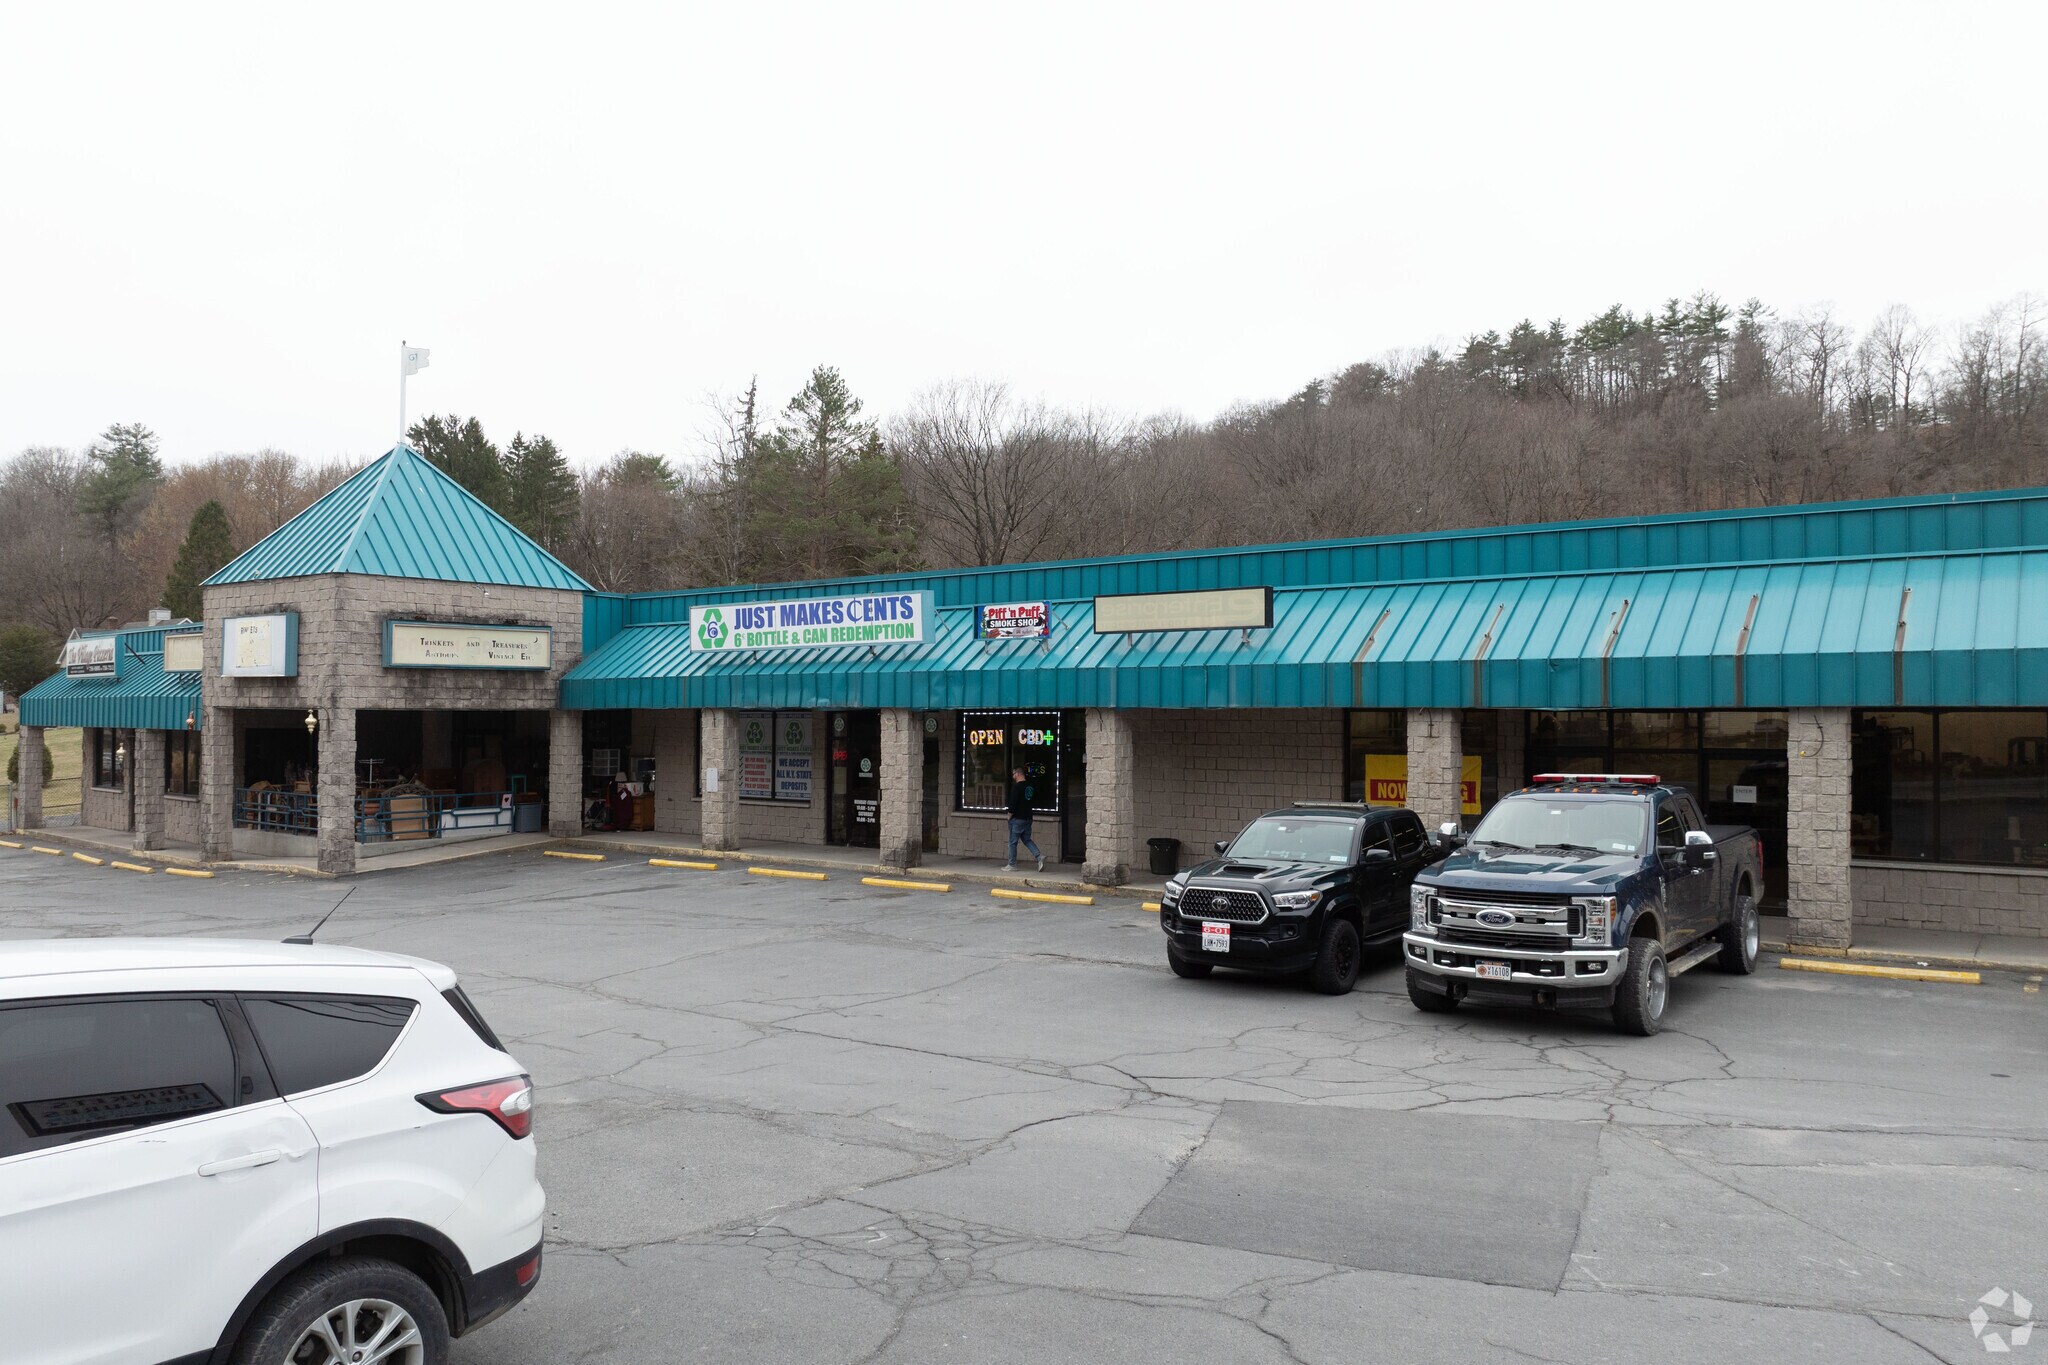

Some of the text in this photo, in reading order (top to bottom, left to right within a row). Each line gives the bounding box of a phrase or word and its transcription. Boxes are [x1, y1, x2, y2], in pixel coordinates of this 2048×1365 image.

[734, 605, 776, 630] JUST
[780, 601, 844, 627] MAKES
[988, 607, 1007, 620] Piff
[1018, 605, 1041, 620] Puff
[990, 618, 1039, 628] SMOKE SHOP
[747, 630, 788, 647] BOTTLE
[792, 631, 800, 644] &
[803, 628, 827, 644] CAN
[831, 623, 914, 643] REDEMPTION
[420, 638, 454, 647] TRINKETS
[492, 640, 528, 649] TREASURES
[969, 729, 1004, 745] OPEN
[779, 759, 809, 768] WE ACCEPT
[776, 770, 785, 778] ALL
[796, 771, 812, 780] STATE
[780, 781, 807, 791] DEPOSITS
[976, 785, 1003, 806] ATM
[1485, 914, 1504, 923] Ford
